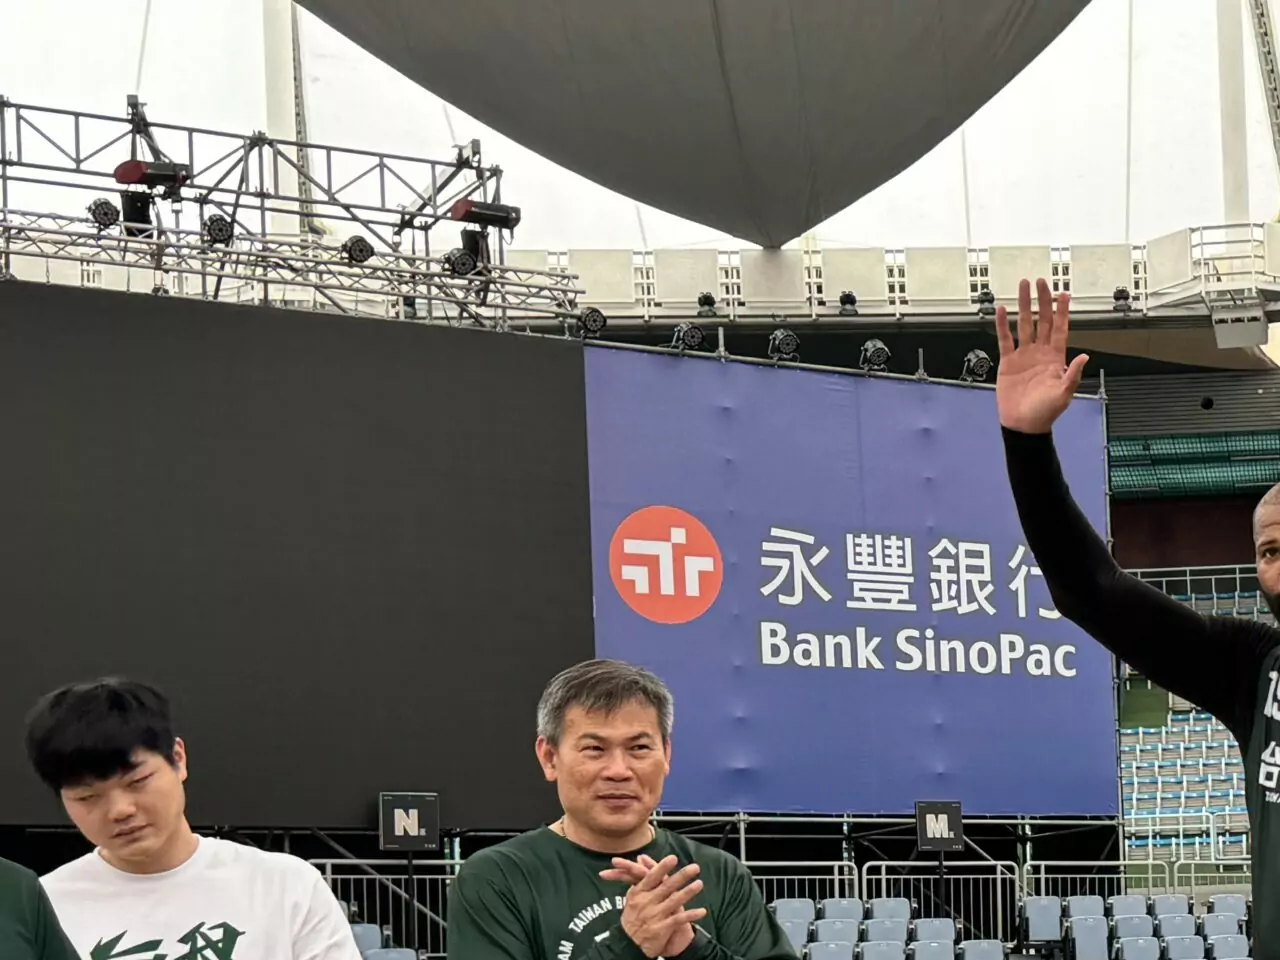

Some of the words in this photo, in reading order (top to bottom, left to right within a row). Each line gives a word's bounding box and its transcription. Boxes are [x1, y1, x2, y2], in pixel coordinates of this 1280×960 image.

[760, 527, 1062, 619] 永豐銀行
[760, 621, 885, 670] Bank
[895, 628, 1077, 677] SinoPac
[568, 897, 612, 933] TAIWAN
